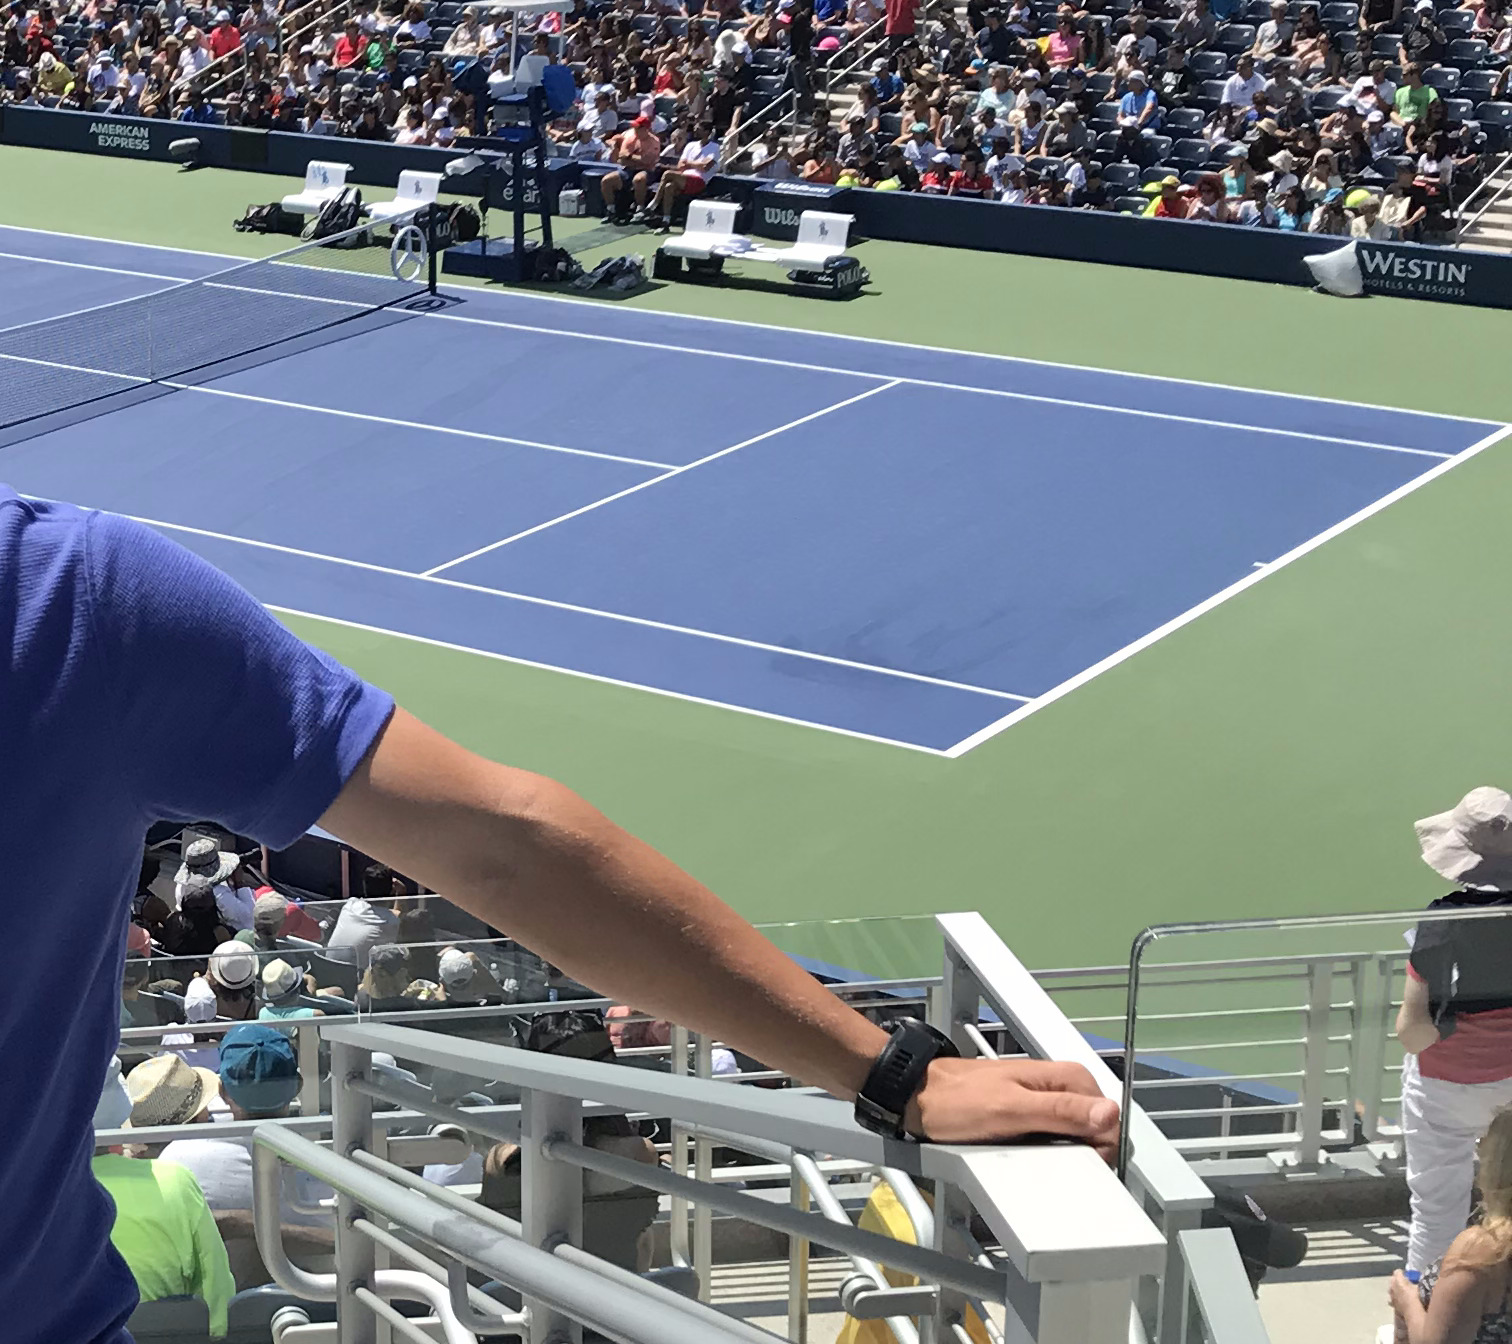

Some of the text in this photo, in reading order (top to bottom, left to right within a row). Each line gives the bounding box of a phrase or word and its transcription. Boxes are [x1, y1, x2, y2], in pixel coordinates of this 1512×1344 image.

[90, 122, 148, 138] AMERICAN
[99, 135, 149, 150] EXPRESS
[764, 207, 800, 226] Wils
[1361, 248, 1467, 284] WESTIN
[837, 267, 861, 288] POLO
[1418, 284, 1465, 296] RESORTS
